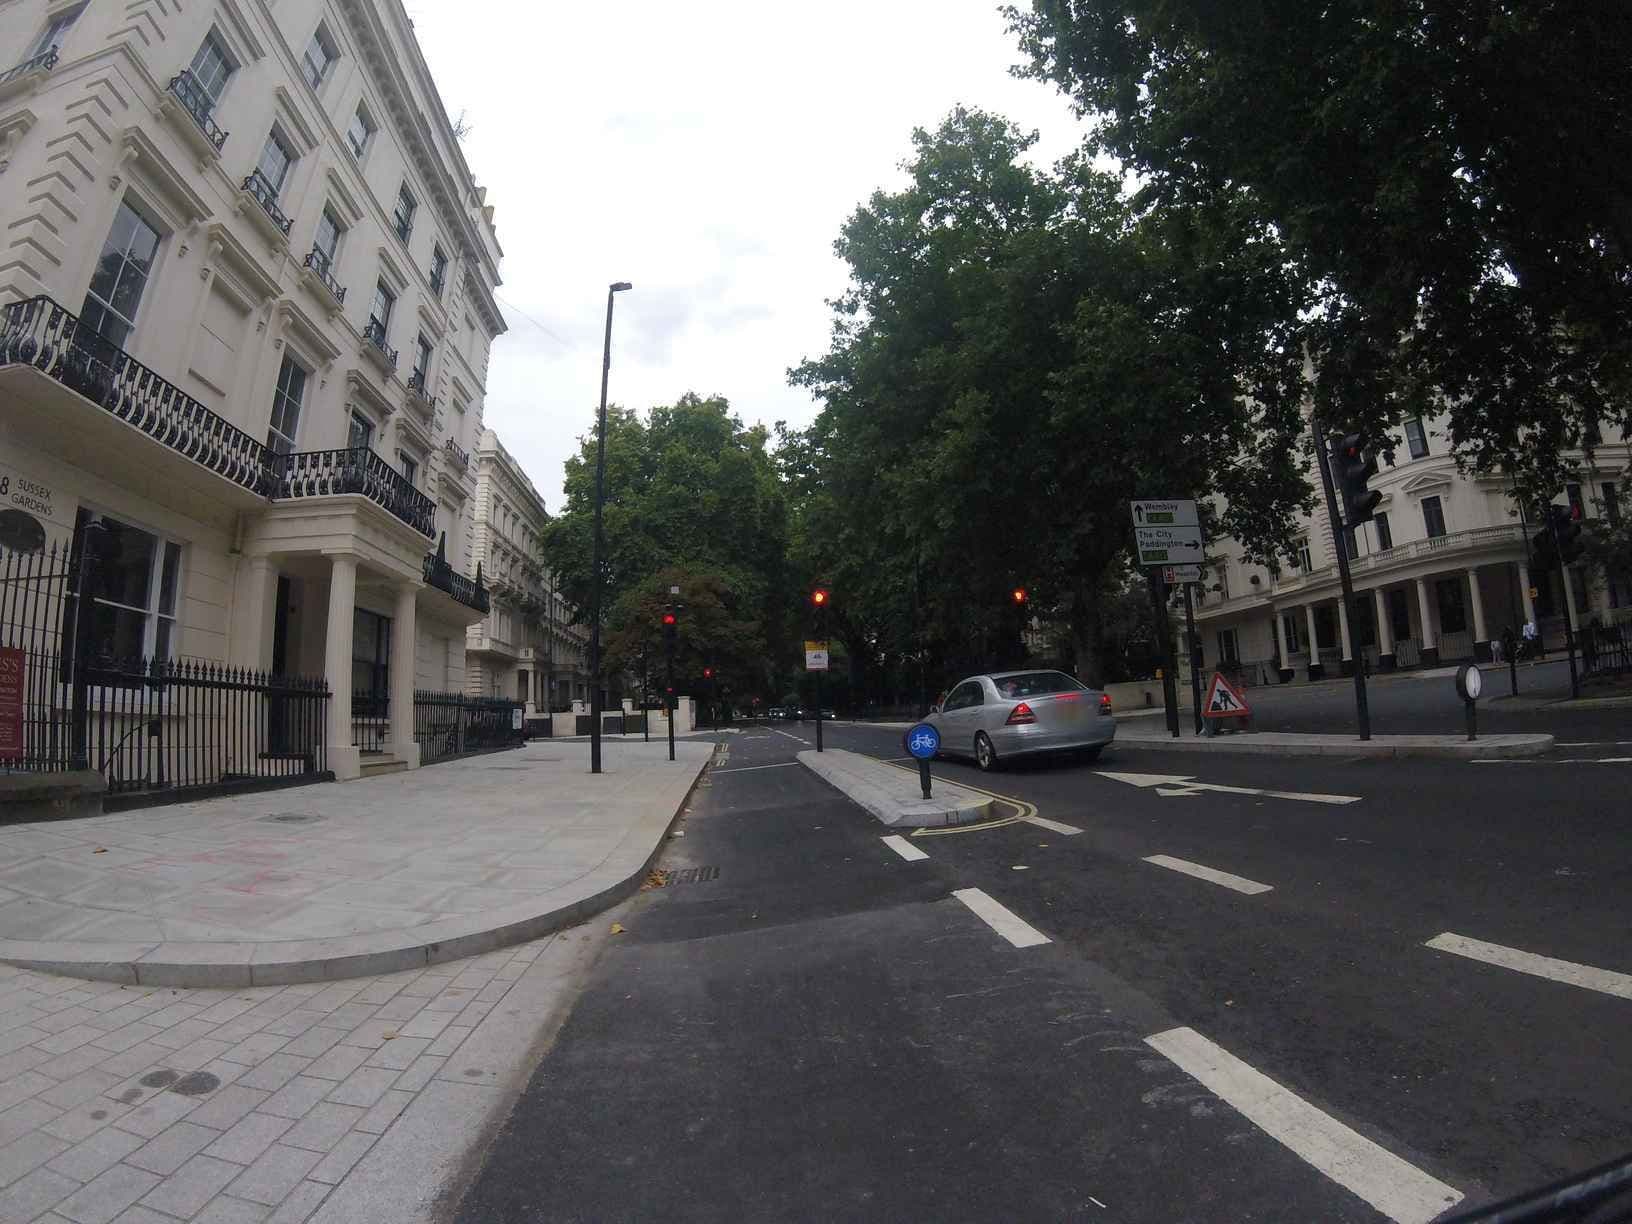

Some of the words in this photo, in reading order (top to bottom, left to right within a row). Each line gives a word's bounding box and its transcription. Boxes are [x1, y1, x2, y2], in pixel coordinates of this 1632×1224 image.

[17, 479, 51, 500] SUSSEX
[11, 493, 53, 516] GARDENS
[1144, 503, 1179, 512] Wembley
[1138, 530, 1153, 539] The
[1156, 530, 1173, 539] City
[1140, 540, 1184, 549] Paddington
